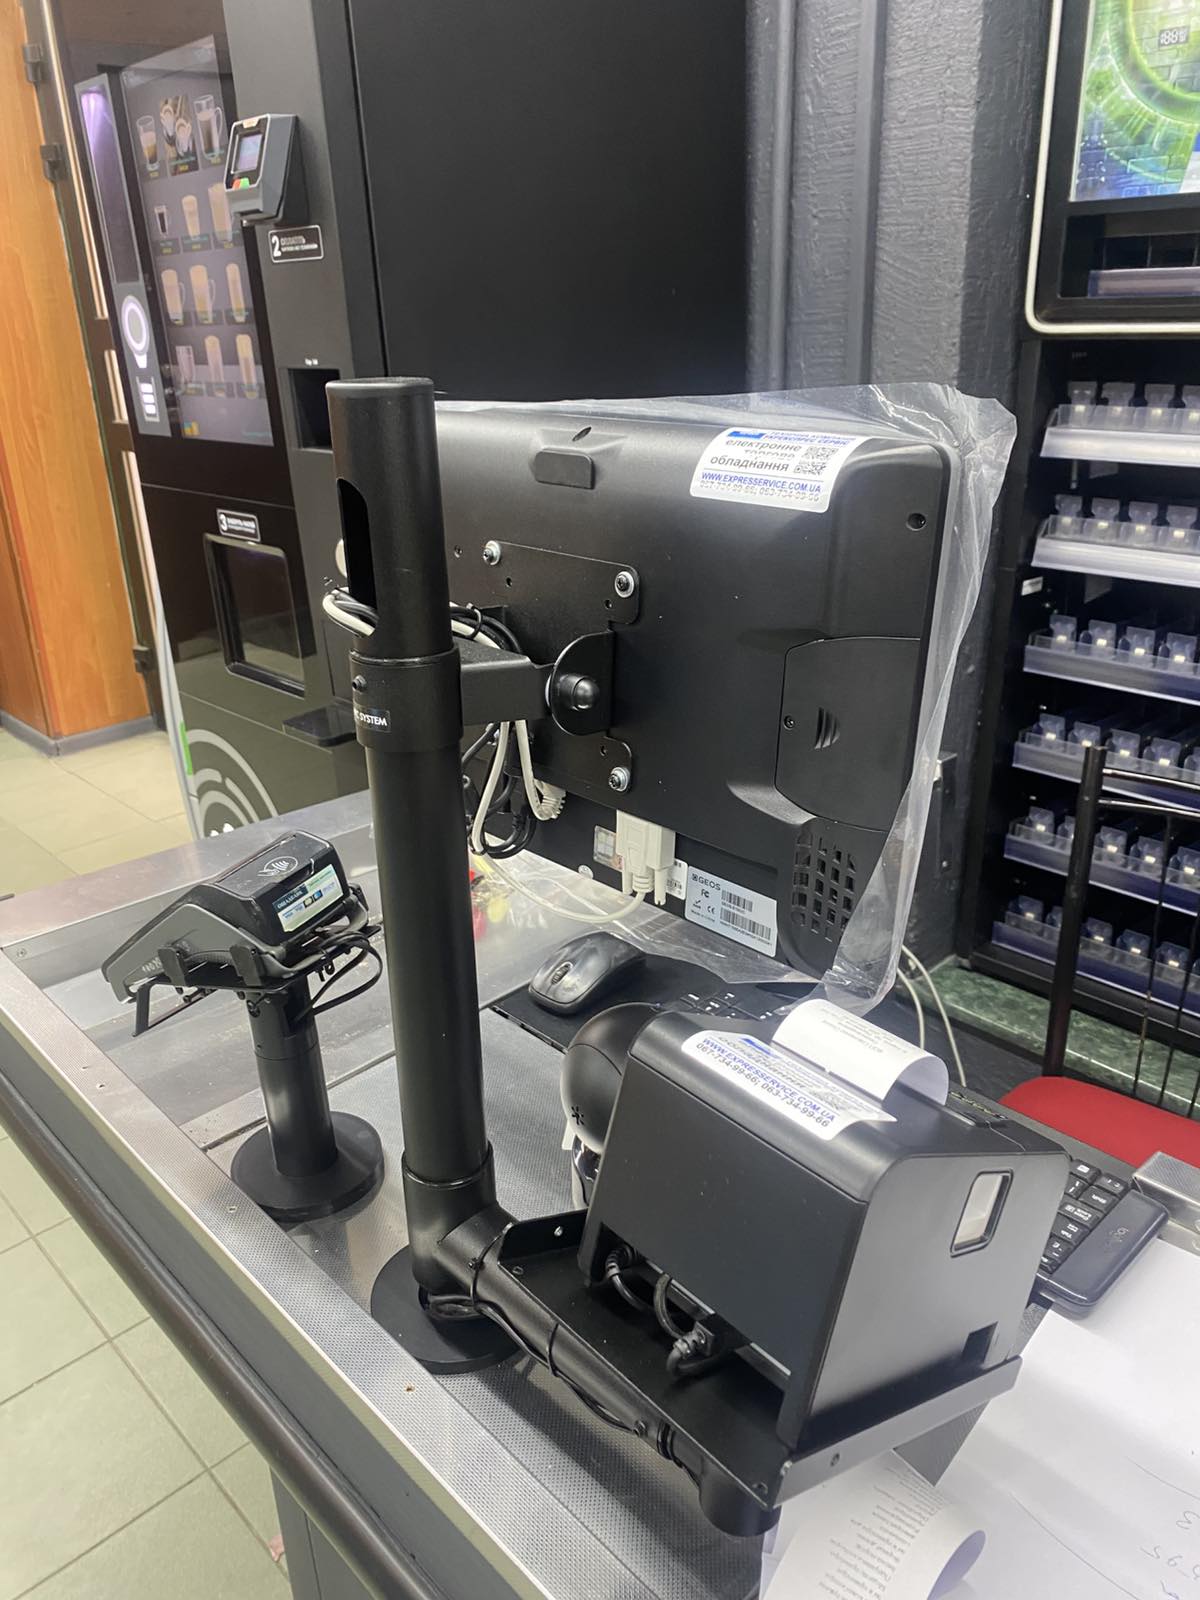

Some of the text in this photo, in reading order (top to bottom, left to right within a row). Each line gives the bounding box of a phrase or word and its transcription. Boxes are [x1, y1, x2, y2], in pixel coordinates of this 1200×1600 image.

[272, 235, 281, 257] 2
[726, 439, 802, 452] електронне
[710, 455, 790, 472] обладнання
[701, 472, 821, 492] WWW.EXPRESSERVICE.COM.UA
[220, 514, 227, 531] 3
[360, 712, 387, 726] SYSTEM
[698, 876, 721, 891] GEOS
[696, 1044, 760, 1086] 067-734-99-66;
[761, 1083, 830, 1127] 063-734-99-66
[702, 1038, 835, 1121] WWW.EXPRESSERVICE.COM.UA
